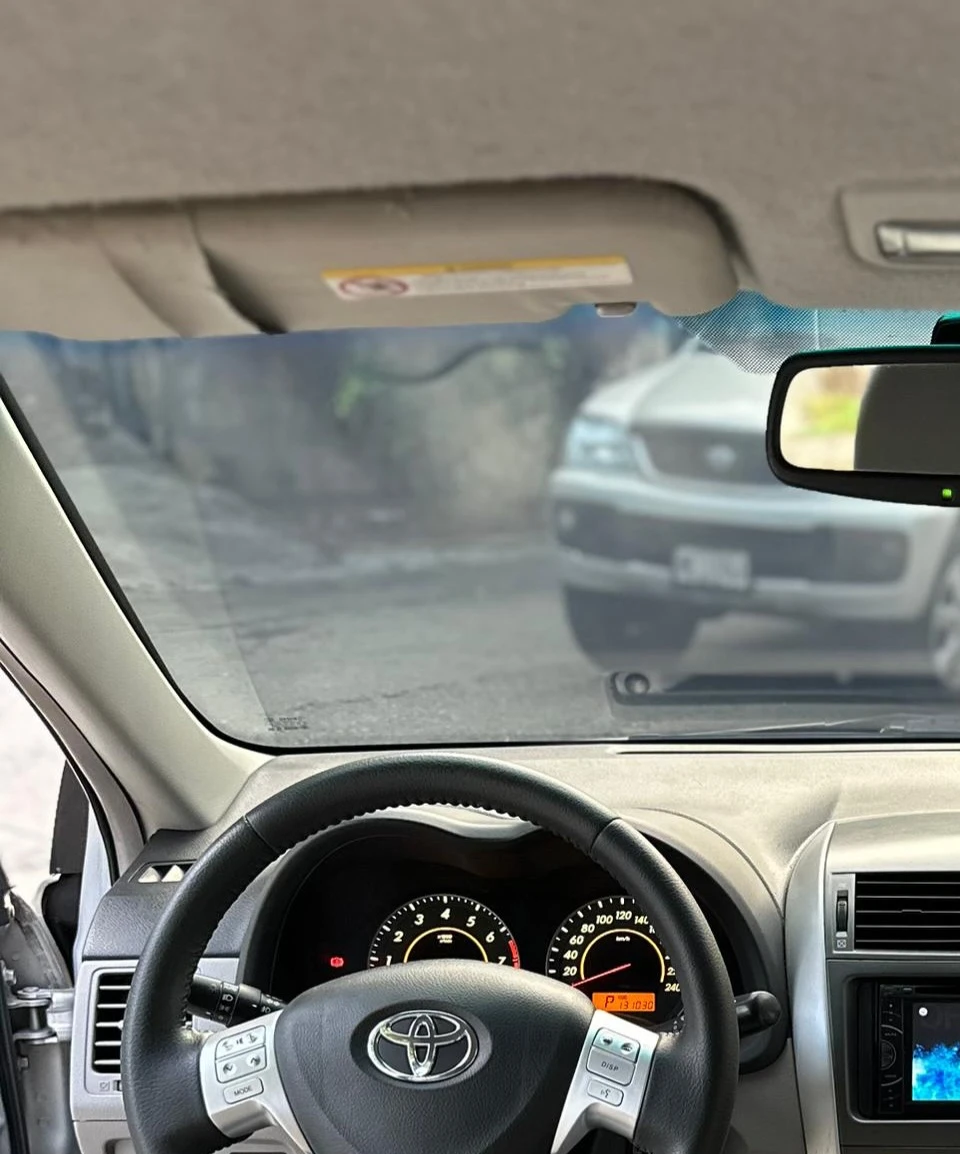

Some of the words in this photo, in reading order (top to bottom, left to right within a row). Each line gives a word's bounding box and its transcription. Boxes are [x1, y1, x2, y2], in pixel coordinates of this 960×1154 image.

[440, 908, 451, 919] 4
[615, 911, 632, 920] 120
[414, 914, 424, 925] 3
[466, 916, 476, 927] 5
[596, 915, 613, 925] 100
[580, 924, 595, 933] 80
[393, 931, 404, 942] 2
[486, 931, 495, 943] 6
[569, 935, 584, 945] 60
[563, 950, 578, 960] 40
[562, 966, 577, 976] 20
[604, 995, 615, 1008] P
[601, 1061, 619, 1071] DISP
[234, 1086, 253, 1097] MODE
